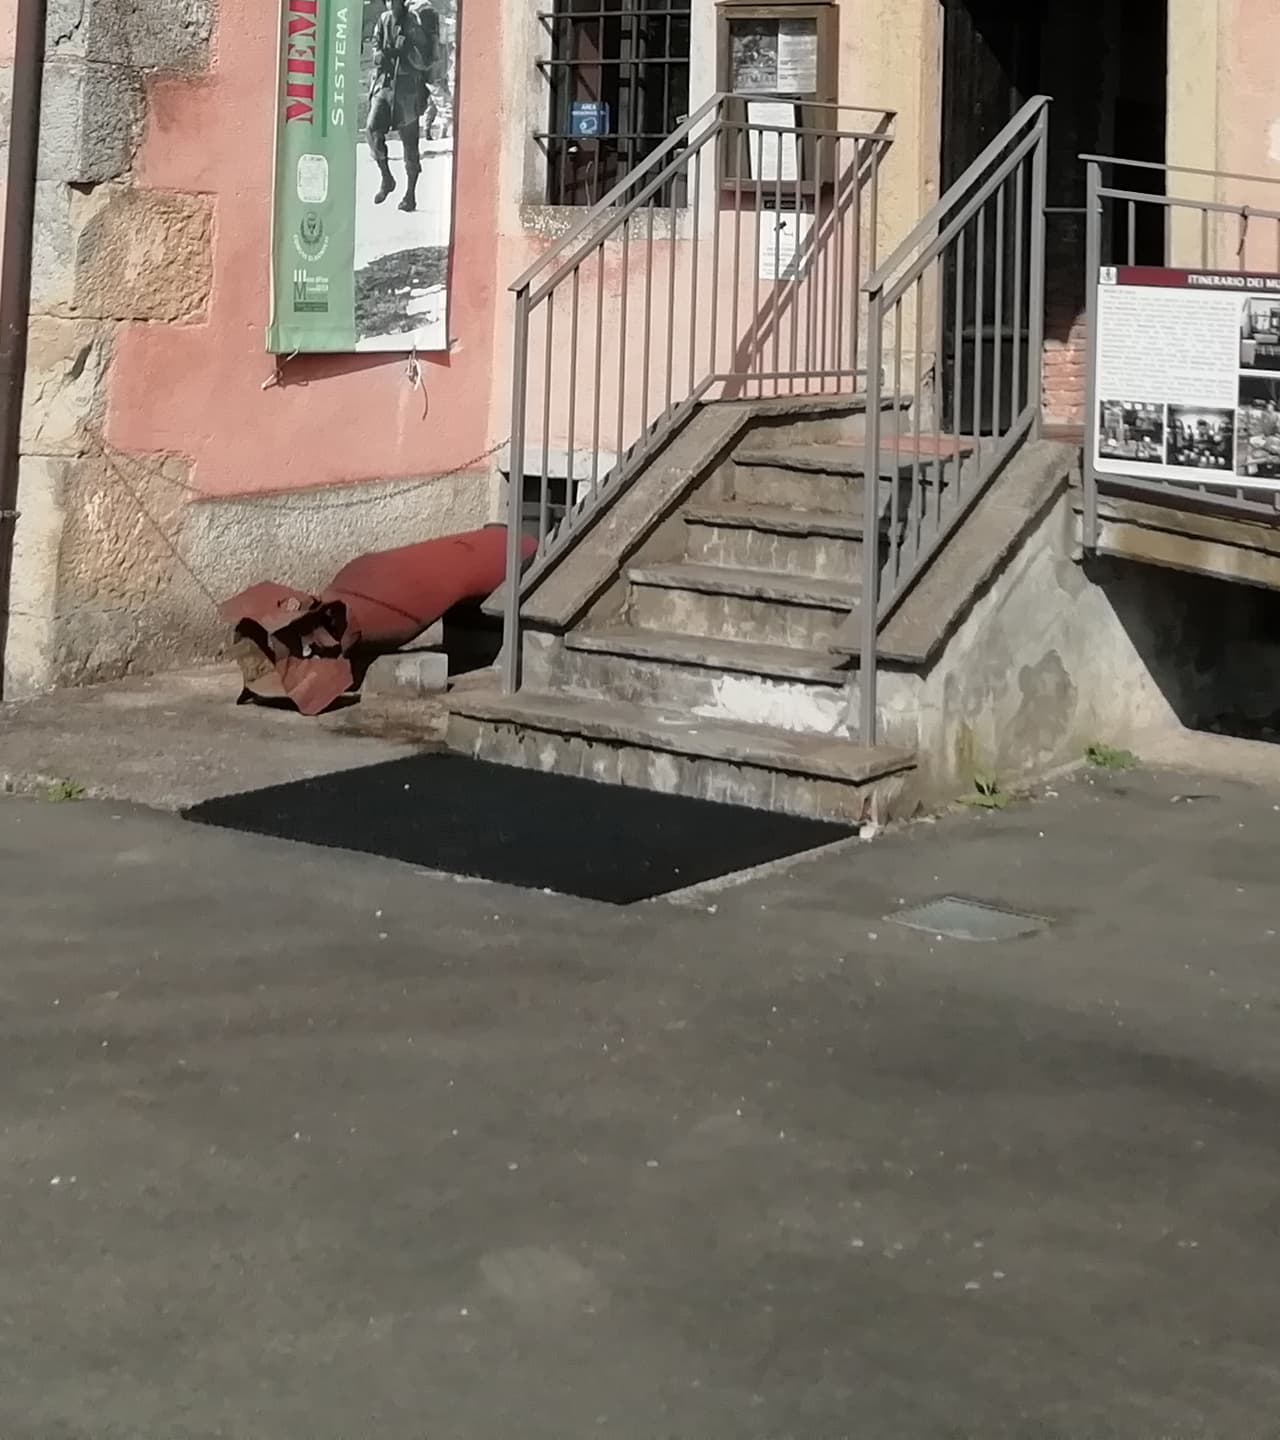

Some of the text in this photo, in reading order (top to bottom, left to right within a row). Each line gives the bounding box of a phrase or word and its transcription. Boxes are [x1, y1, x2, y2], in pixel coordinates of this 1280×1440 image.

[331, 7, 349, 126] SISTEMA
[1187, 273, 1245, 287] ITINERARIO
[1246, 276, 1264, 288] DEI
